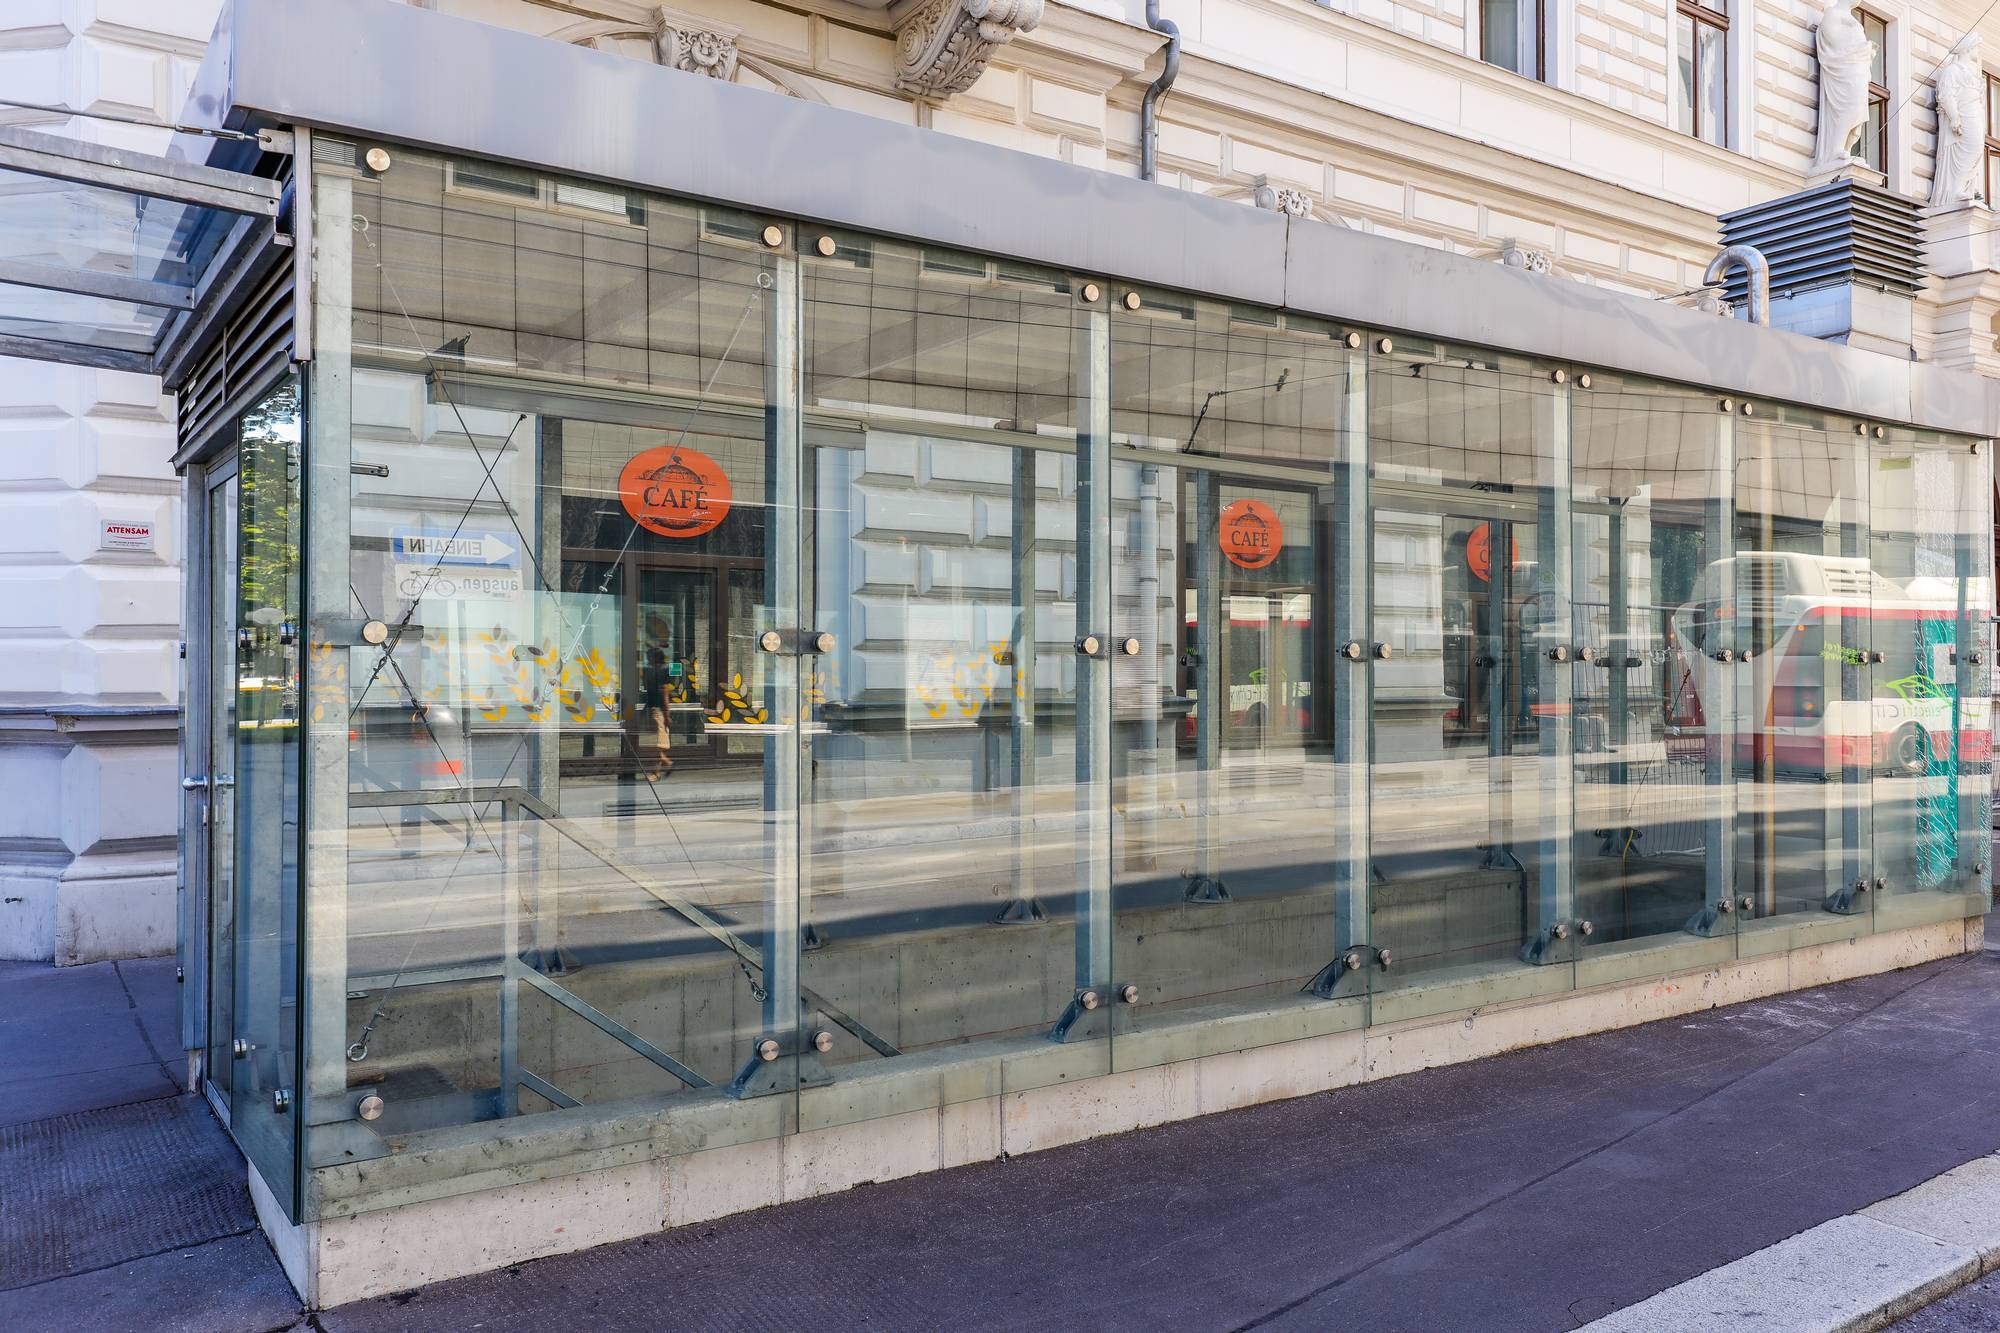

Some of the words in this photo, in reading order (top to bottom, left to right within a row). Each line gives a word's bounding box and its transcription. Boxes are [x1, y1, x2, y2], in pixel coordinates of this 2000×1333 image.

[643, 486, 708, 510] CAFÉ
[107, 526, 149, 535] ATTENSAM
[1231, 529, 1269, 547] CAFÉ
